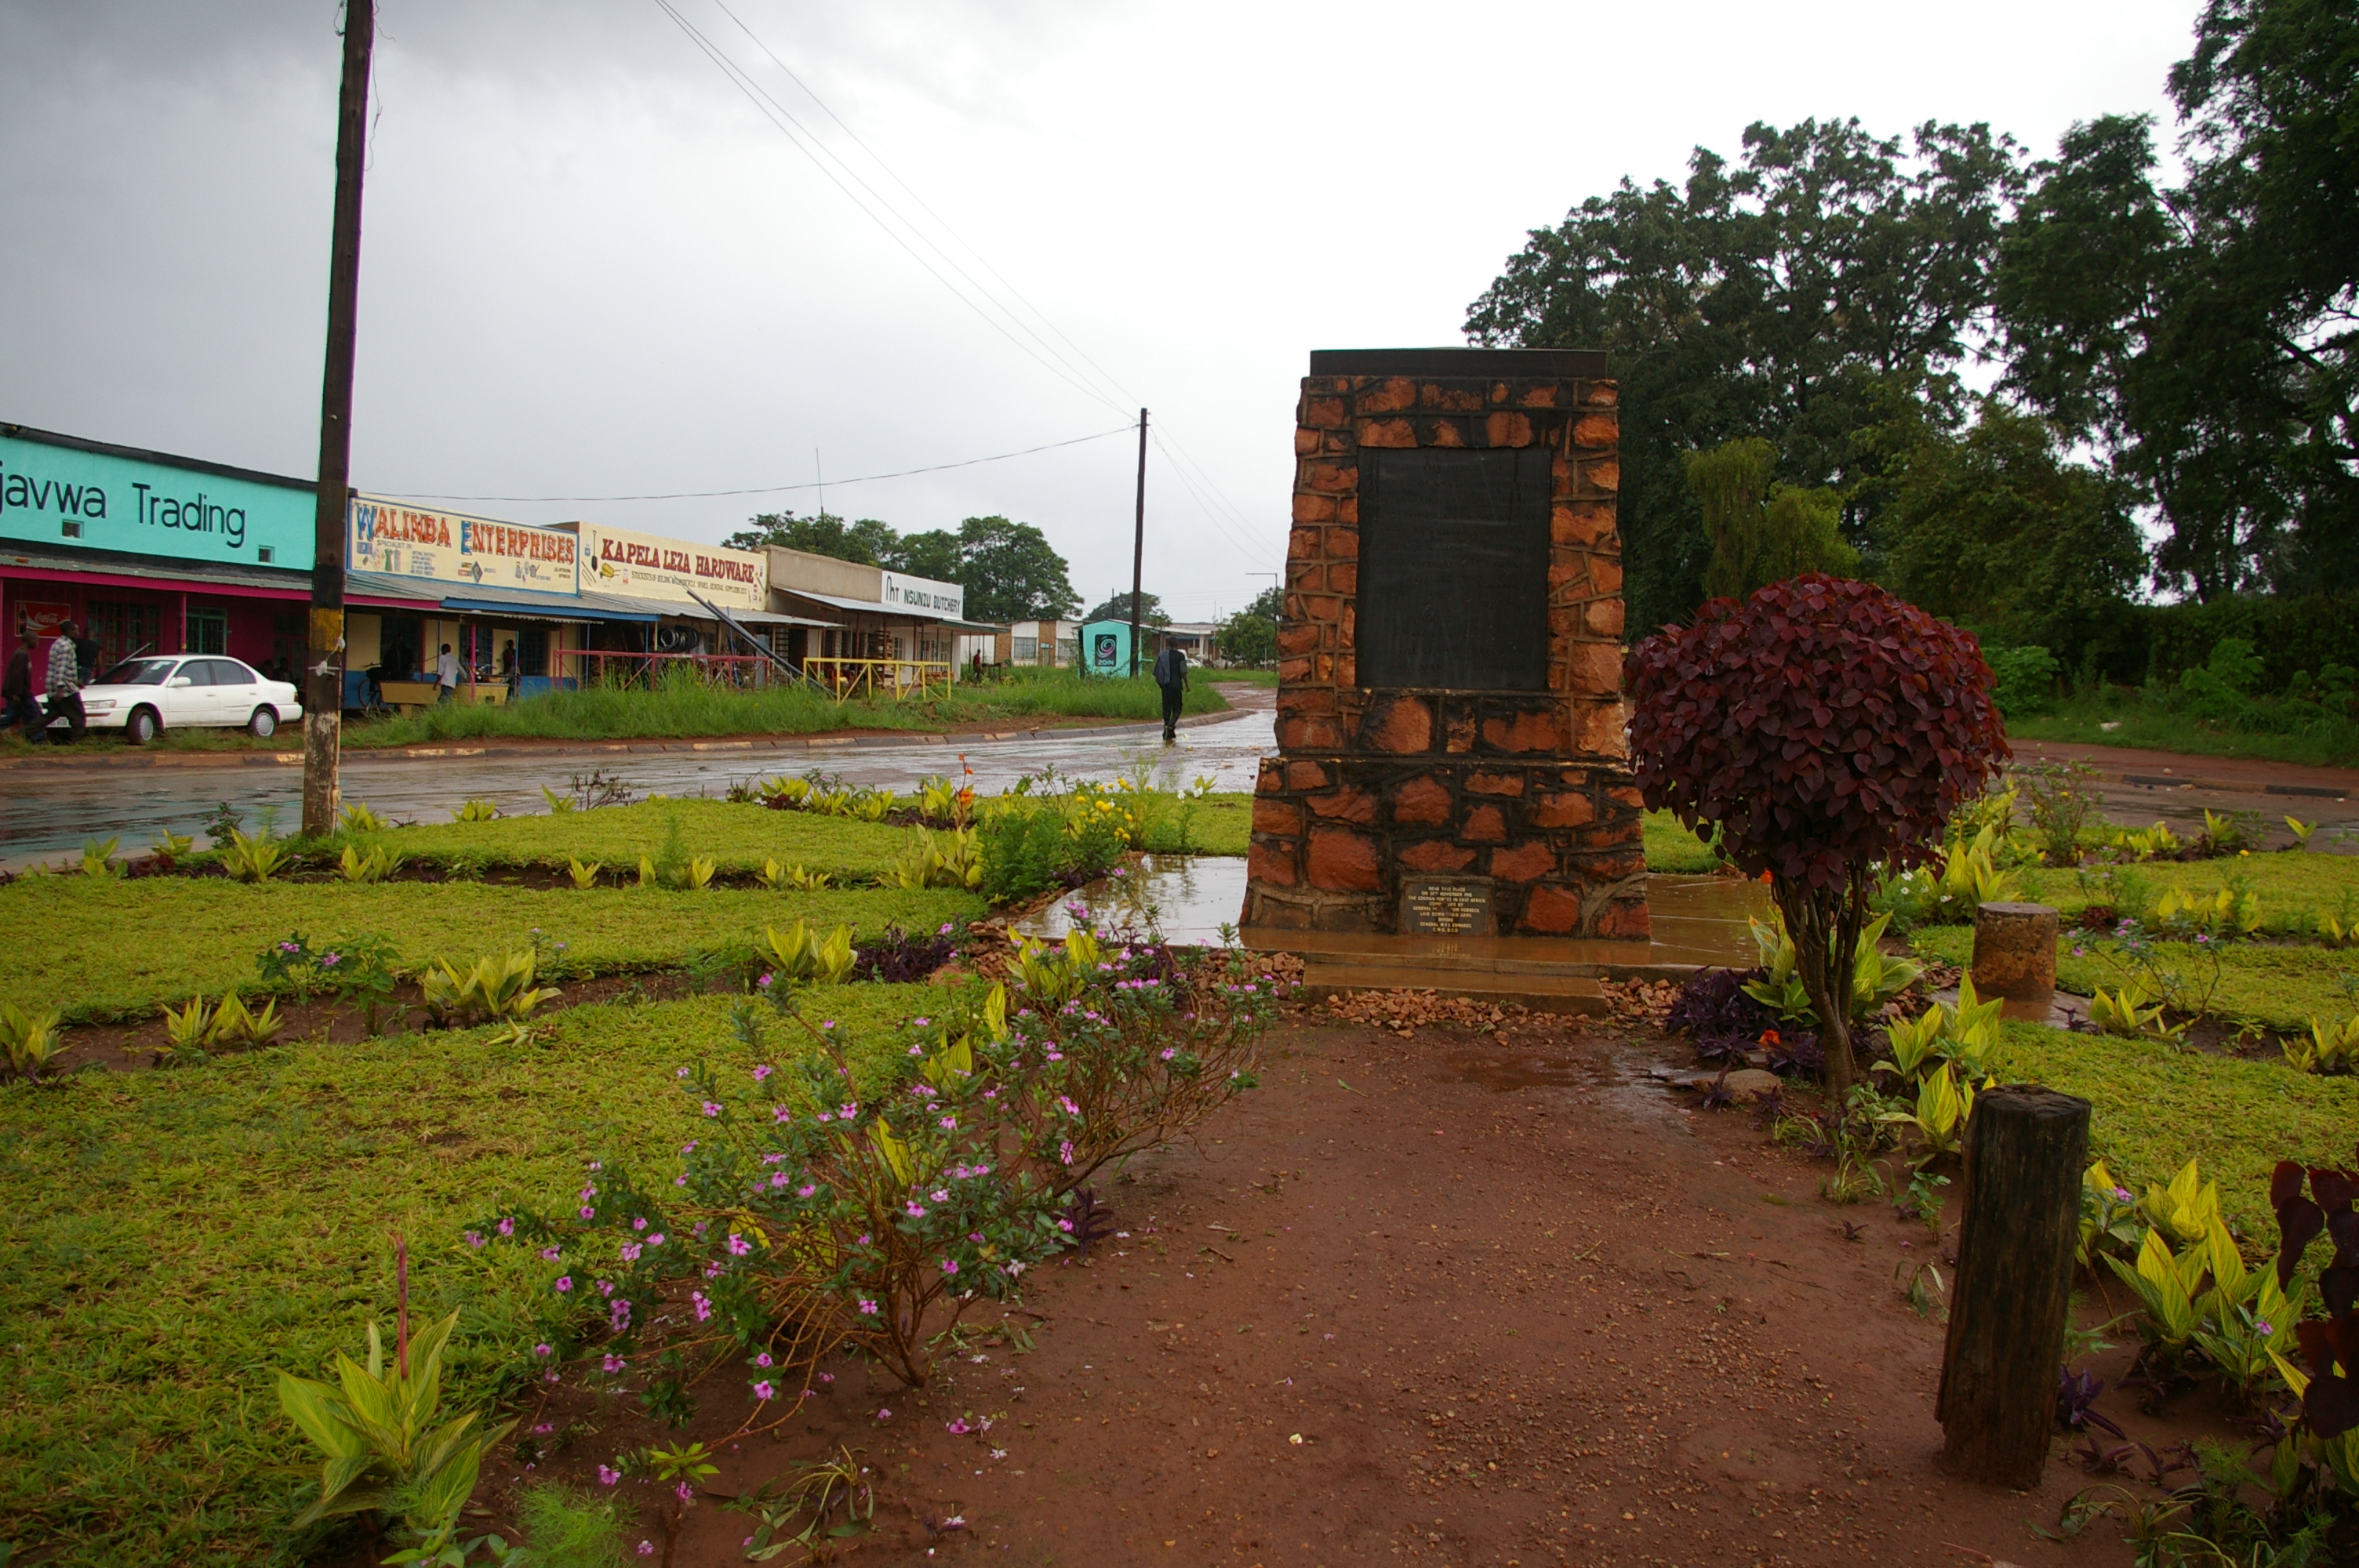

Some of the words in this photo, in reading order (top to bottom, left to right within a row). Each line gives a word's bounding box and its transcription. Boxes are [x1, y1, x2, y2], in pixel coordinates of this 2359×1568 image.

[132, 481, 246, 549] Trading
[356, 503, 452, 548] WALINDA
[460, 521, 575, 565] ENTERPRISES
[663, 549, 691, 574] LEZA
[695, 554, 754, 583] HARDWARE
[903, 588, 932, 608] NSUNZU
[933, 594, 961, 614] BUTCHERY
